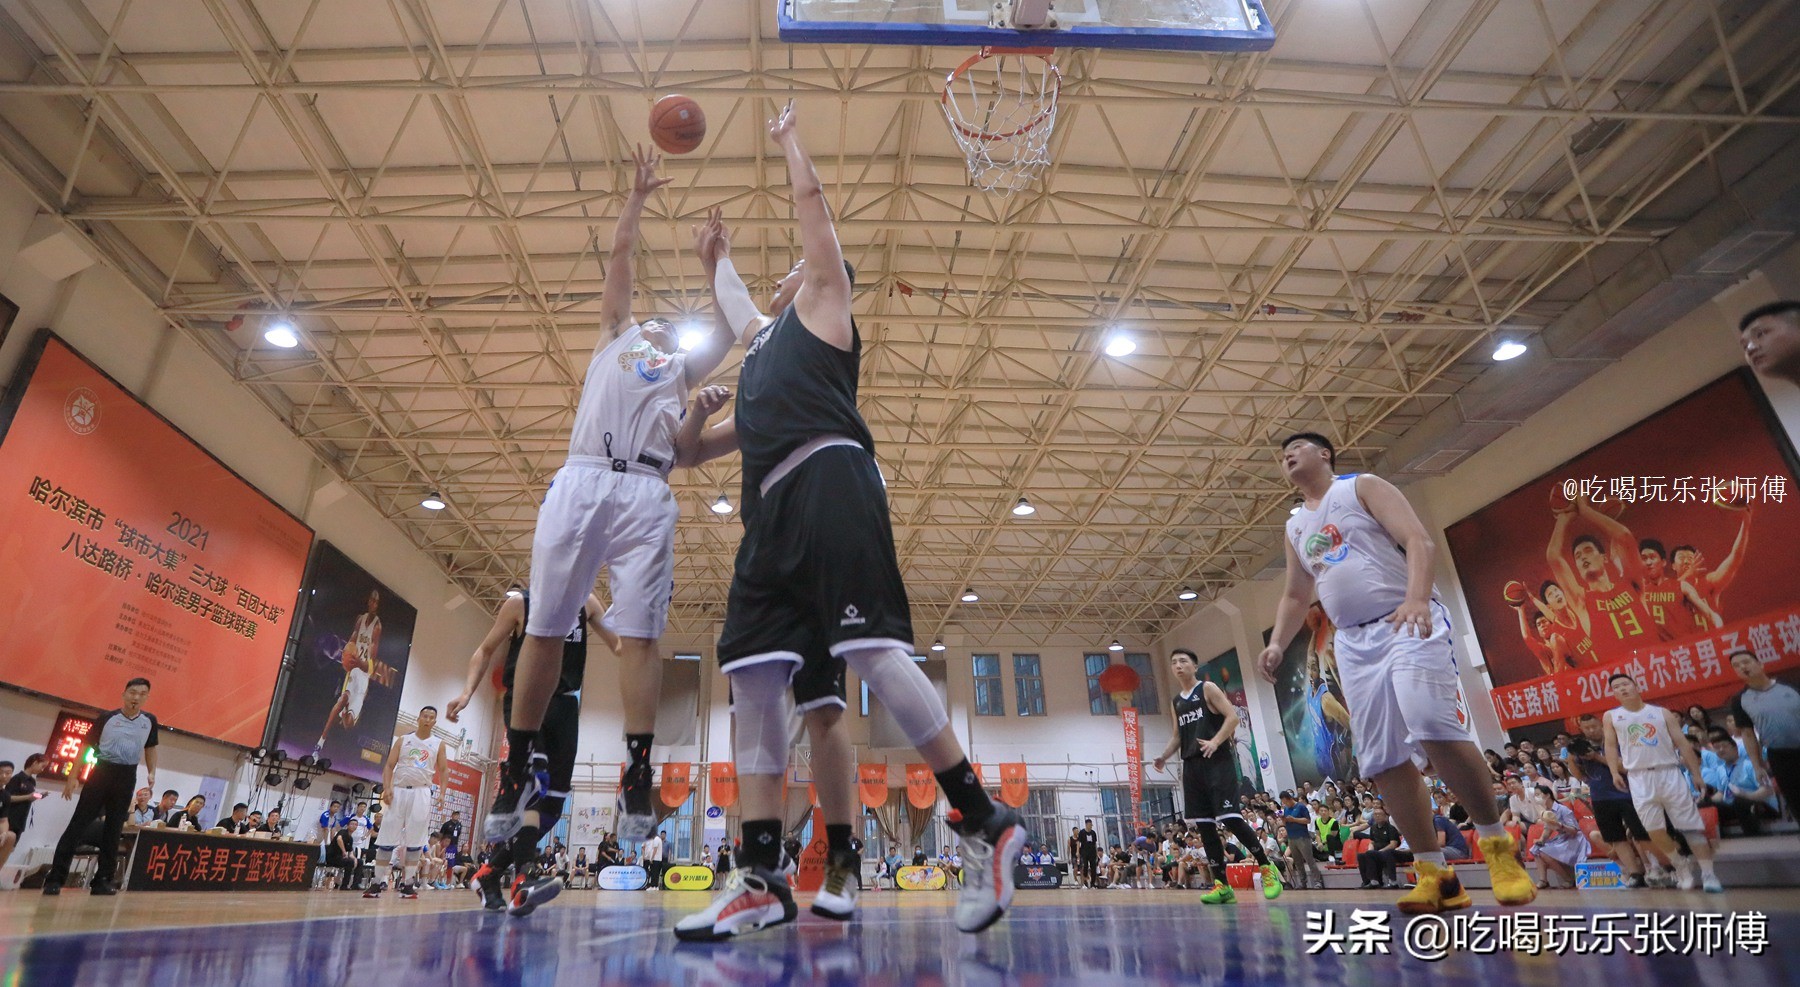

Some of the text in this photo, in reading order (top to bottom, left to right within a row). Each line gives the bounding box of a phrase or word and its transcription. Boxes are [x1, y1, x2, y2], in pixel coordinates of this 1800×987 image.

[166, 511, 209, 551] 2021
[1596, 591, 1633, 611] CHINA
[1609, 608, 1643, 640] 13
[1652, 605, 1666, 625] 9
[1694, 614, 1708, 632] 4
[1495, 614, 1800, 720] 八达路桥·202哈尔滨男子篮球
[60, 736, 81, 758] 25
[146, 843, 308, 883] 哈尔滨男子篮球联赛
